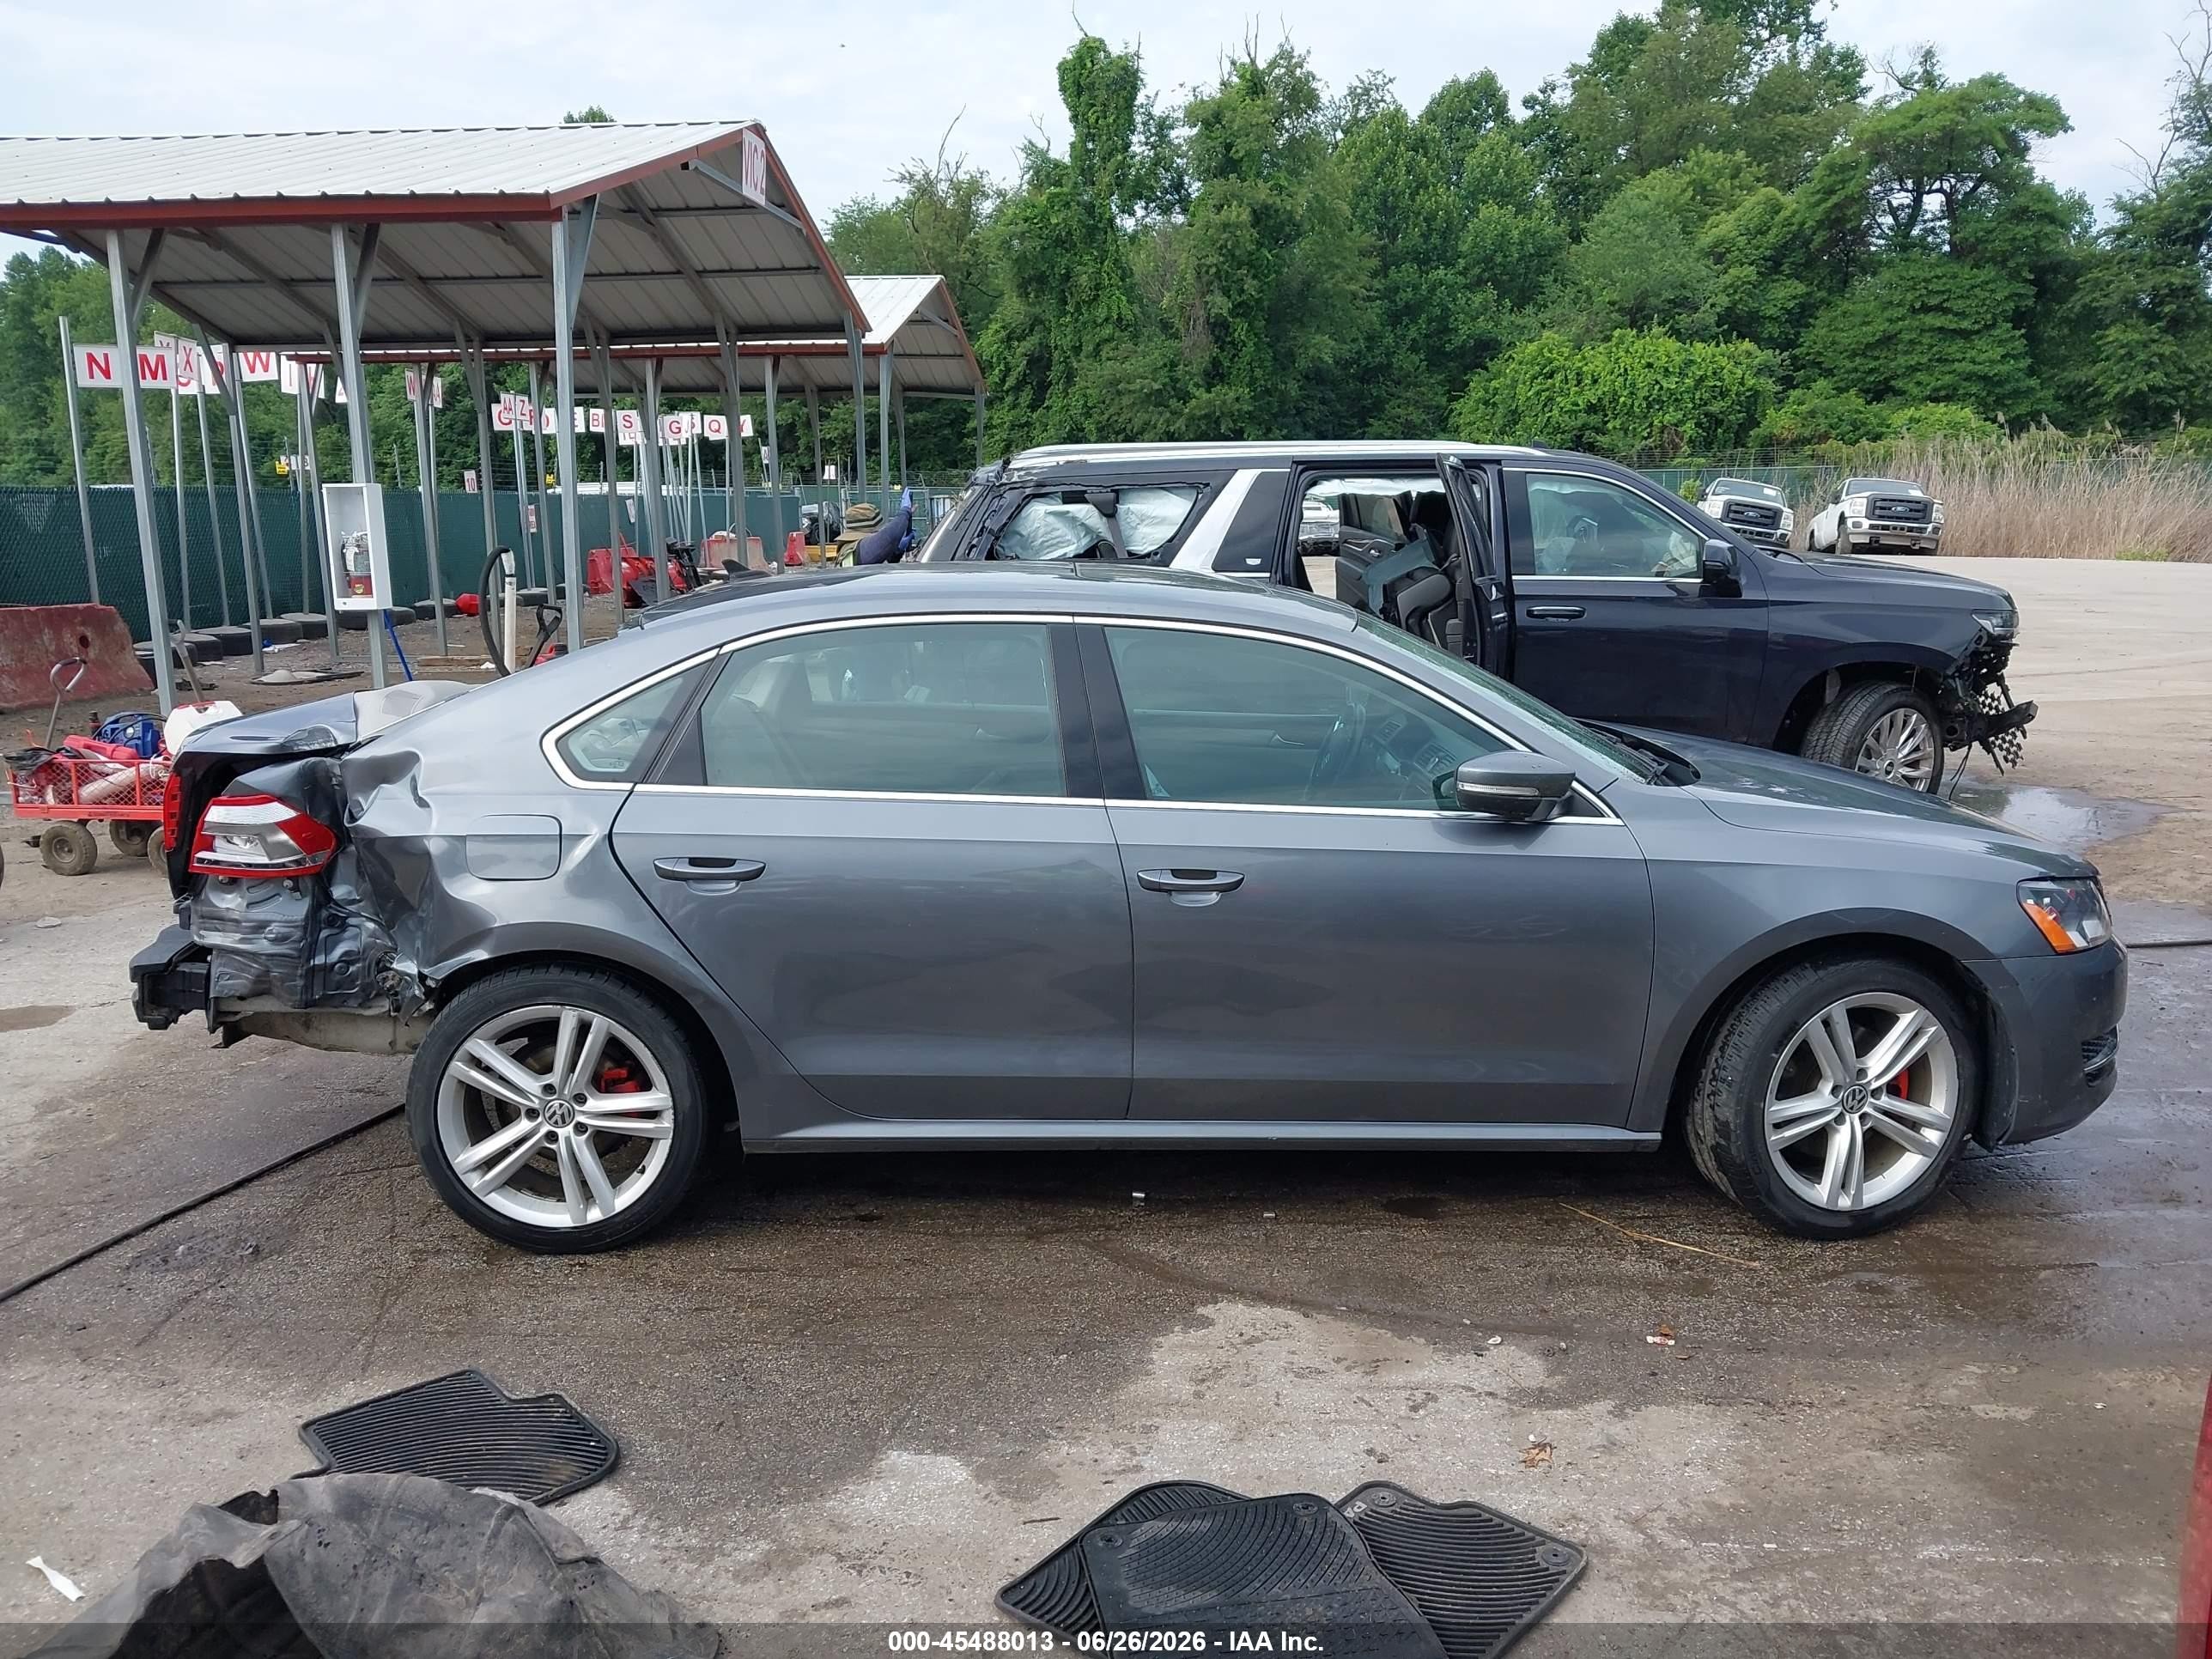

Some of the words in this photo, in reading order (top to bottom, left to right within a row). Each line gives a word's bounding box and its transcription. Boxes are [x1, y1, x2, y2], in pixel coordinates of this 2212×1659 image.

[86, 351, 112, 380] N
[138, 353, 167, 380] M
[183, 345, 193, 373] X
[242, 350, 270, 374] W
[520, 398, 526, 416] Z
[622, 414, 634, 428] S
[668, 420, 682, 434] G
[708, 419, 721, 434] Q
